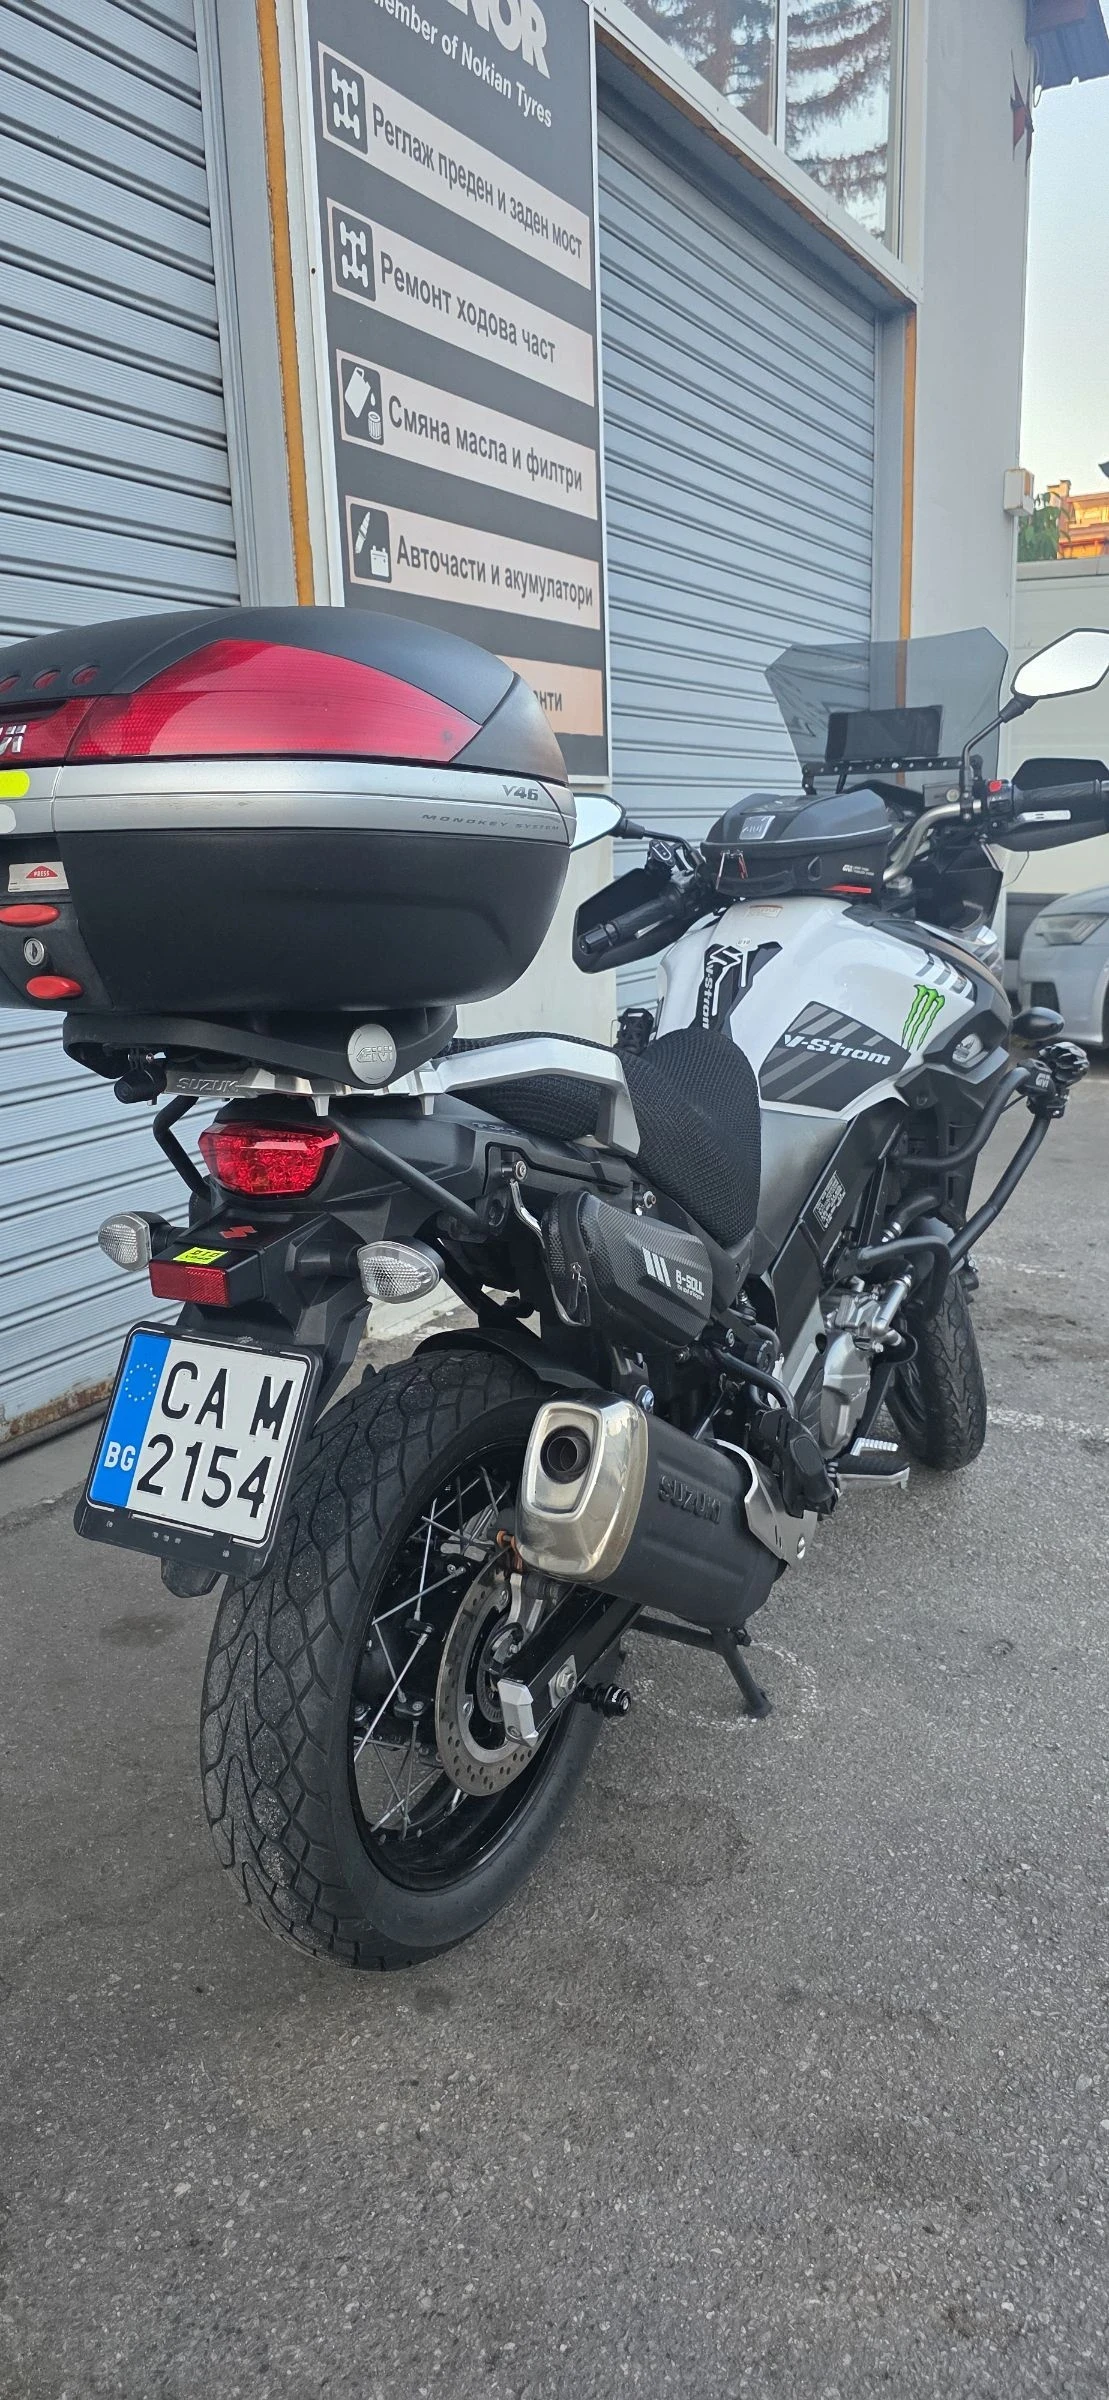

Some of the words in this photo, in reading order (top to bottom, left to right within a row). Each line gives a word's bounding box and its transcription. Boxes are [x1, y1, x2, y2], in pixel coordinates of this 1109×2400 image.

[373, 0, 438, 45] ember
[441, 34, 459, 60] of
[461, 41, 512, 99] Nokian
[516, 81, 552, 128] Tyres
[372, 102, 435, 171] Реглаж
[438, 152, 494, 206] преден
[497, 187, 507, 215] и
[510, 196, 549, 240] заден
[552, 222, 583, 259] мост
[380, 250, 452, 314] Ремонт
[456, 296, 518, 346] ходова
[521, 328, 556, 364] част
[388, 395, 451, 446] Смяна
[455, 426, 508, 465] масла
[512, 446, 522, 471] и
[526, 446, 583, 494] филтри
[396, 534, 487, 584] Авточасти
[490, 563, 501, 587] и
[504, 566, 594, 611] акумулатори
[533, 689, 563, 712] нти
[421, 813, 509, 828] MONOKEY
[502, 784, 539, 801] V46
[33, 869, 50, 878] PRESS
[702, 963, 715, 1031] V-Strom
[356, 1046, 393, 1063] GIVI
[784, 1034, 891, 1066] V-Strom
[161, 1360, 228, 1430] CA
[249, 1375, 294, 1441] M
[103, 1440, 136, 1472] BG
[136, 1433, 272, 1520] 2154
